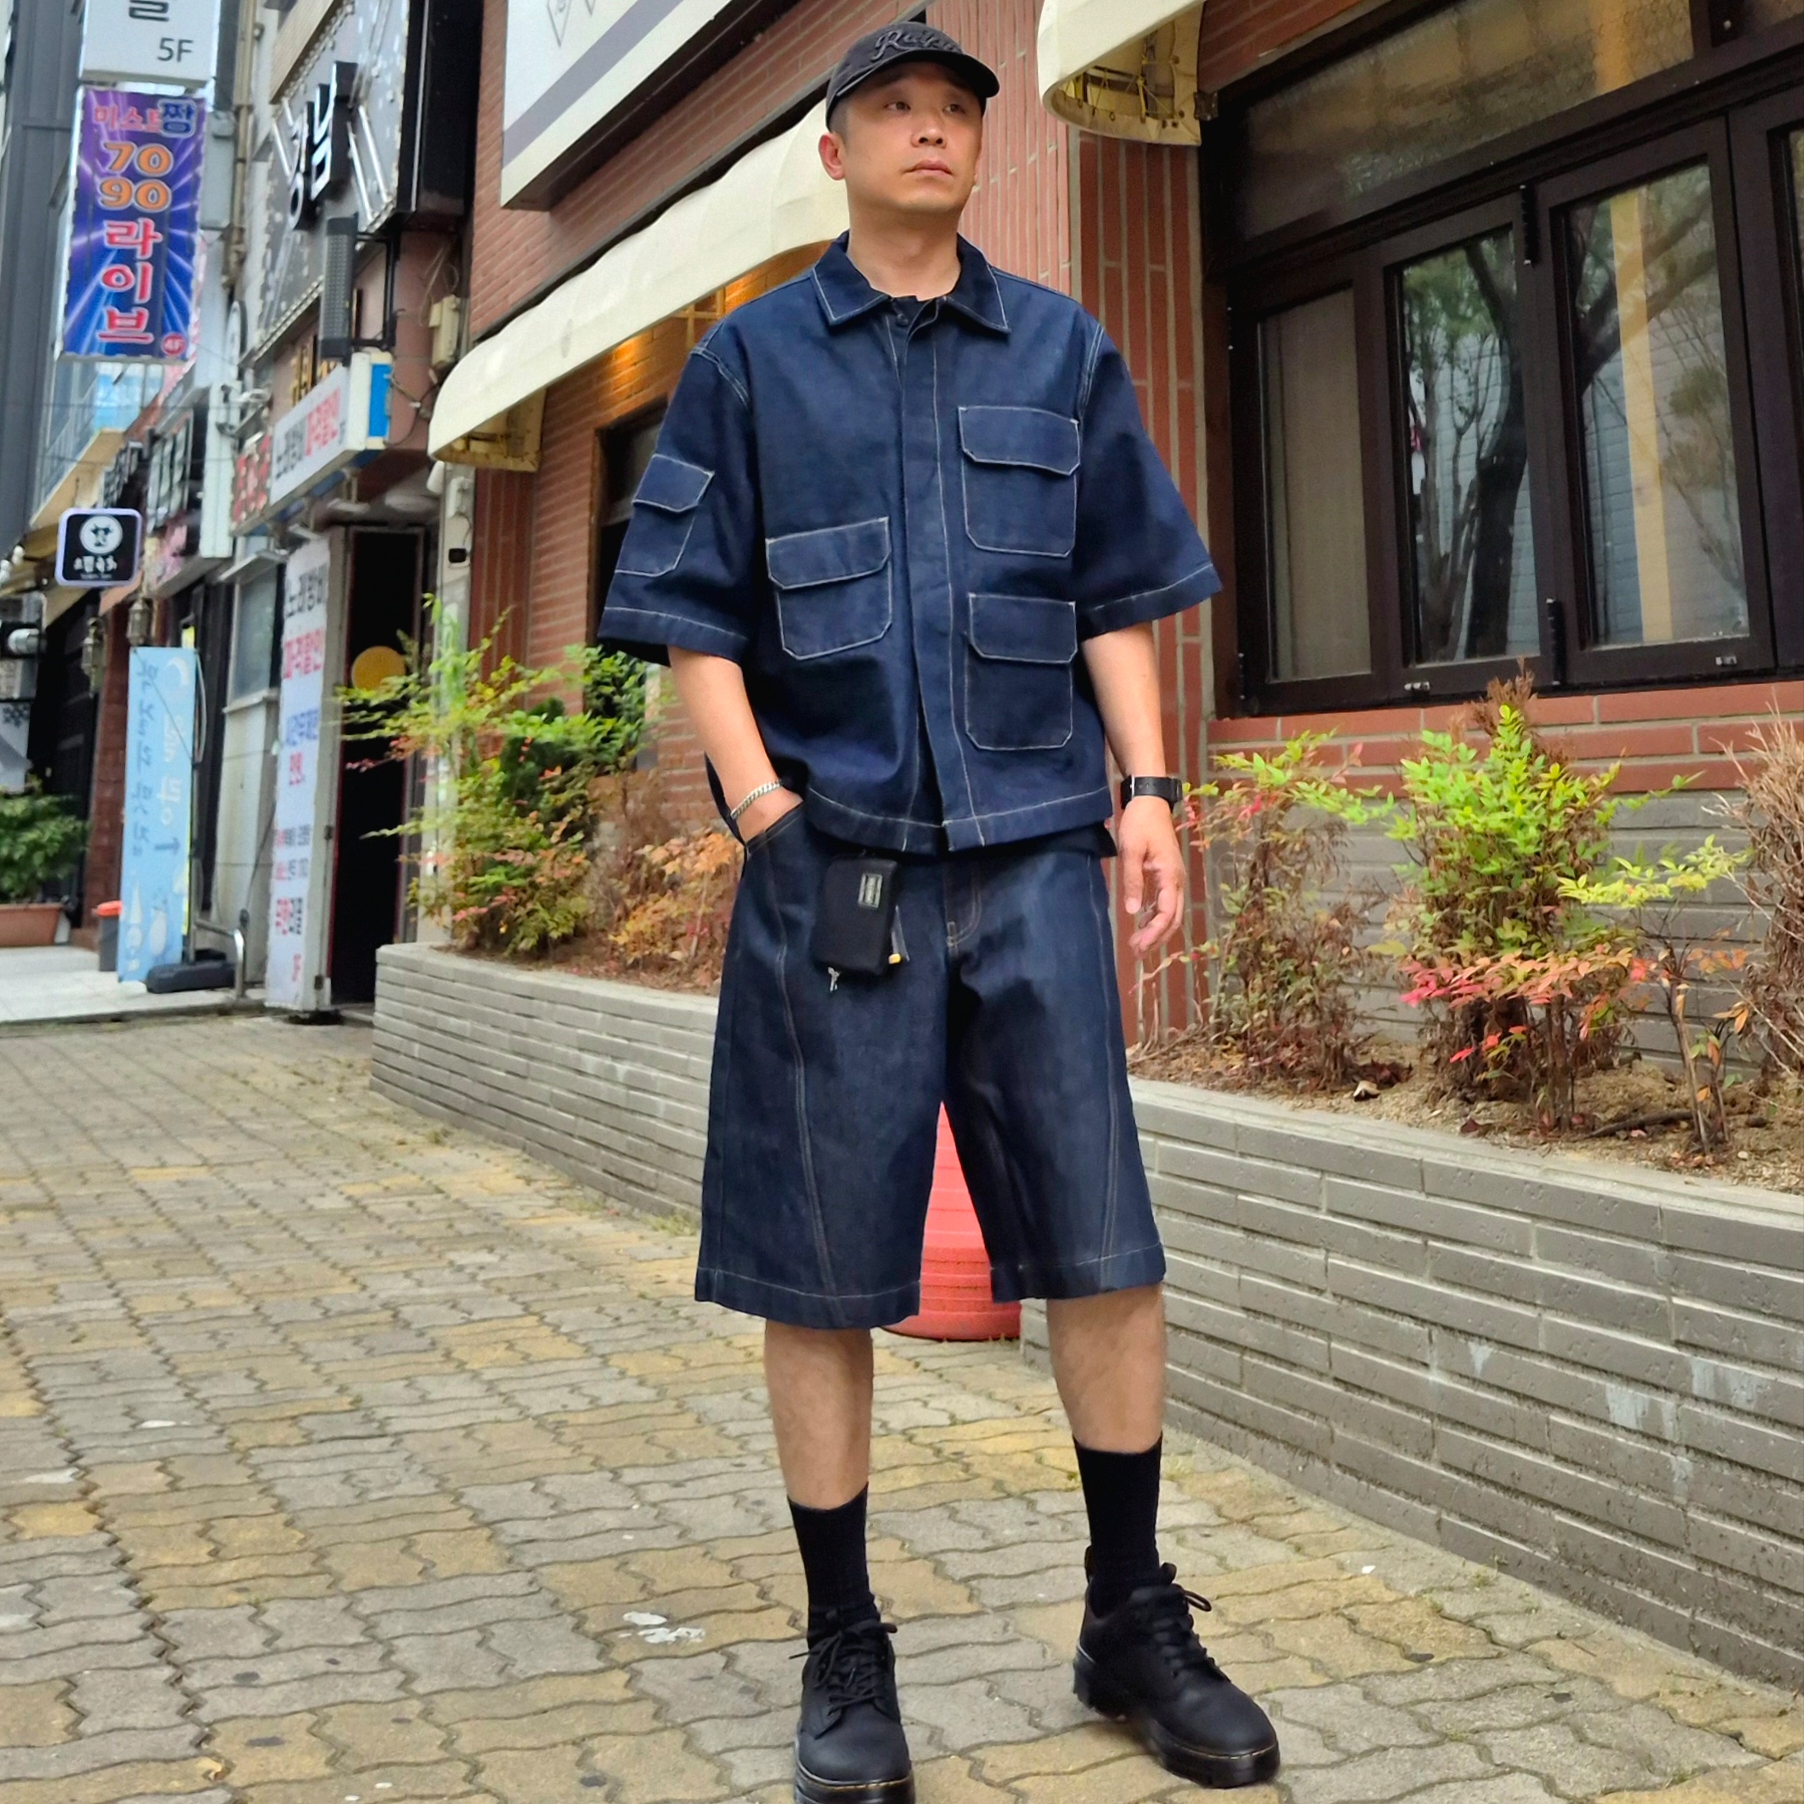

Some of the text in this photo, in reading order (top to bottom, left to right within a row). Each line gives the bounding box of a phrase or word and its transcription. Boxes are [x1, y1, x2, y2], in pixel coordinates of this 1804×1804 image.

[157, 37, 194, 63] 5F
[101, 140, 174, 177] 70
[98, 177, 172, 213] 90
[96, 217, 163, 344] 라이브
